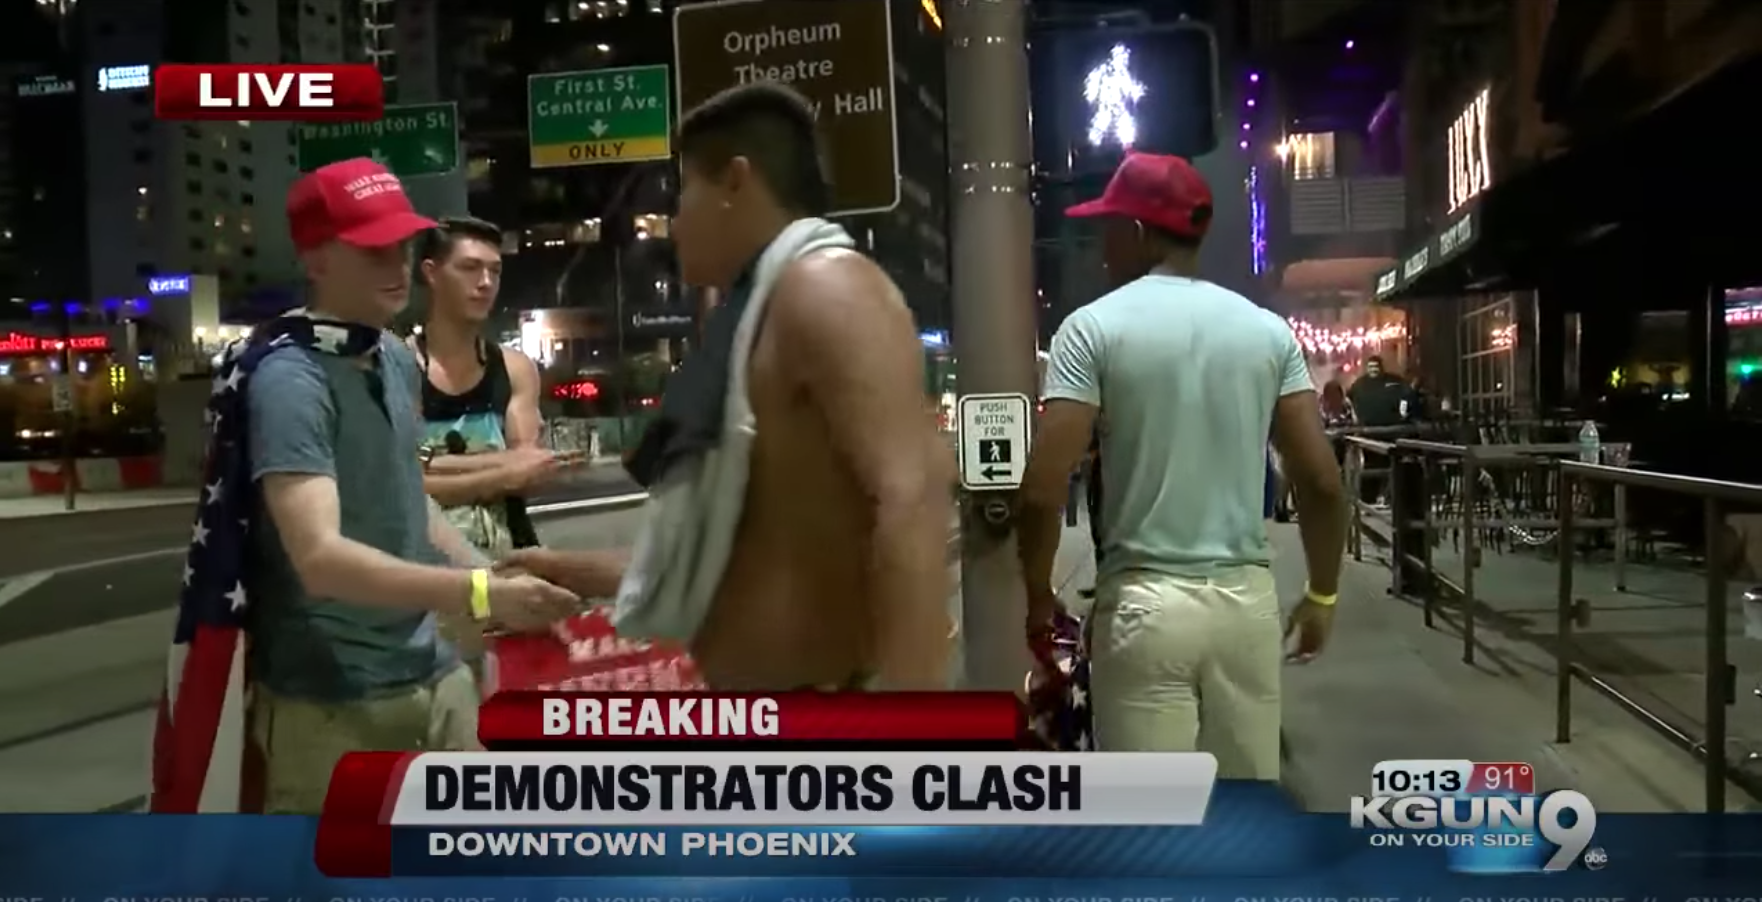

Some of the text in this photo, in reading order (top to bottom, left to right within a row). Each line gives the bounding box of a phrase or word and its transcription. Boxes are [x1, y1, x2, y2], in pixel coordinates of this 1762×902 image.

[723, 21, 842, 56] Orpheum
[734, 58, 833, 87] Theatre
[555, 75, 642, 96] First St.
[537, 95, 664, 117] Central Ave.
[834, 87, 884, 116] Hall
[569, 142, 625, 160] ONLY
[980, 402, 1008, 413] PUSH
[974, 414, 1015, 426] BUTTON
[985, 426, 1006, 437] FOR
